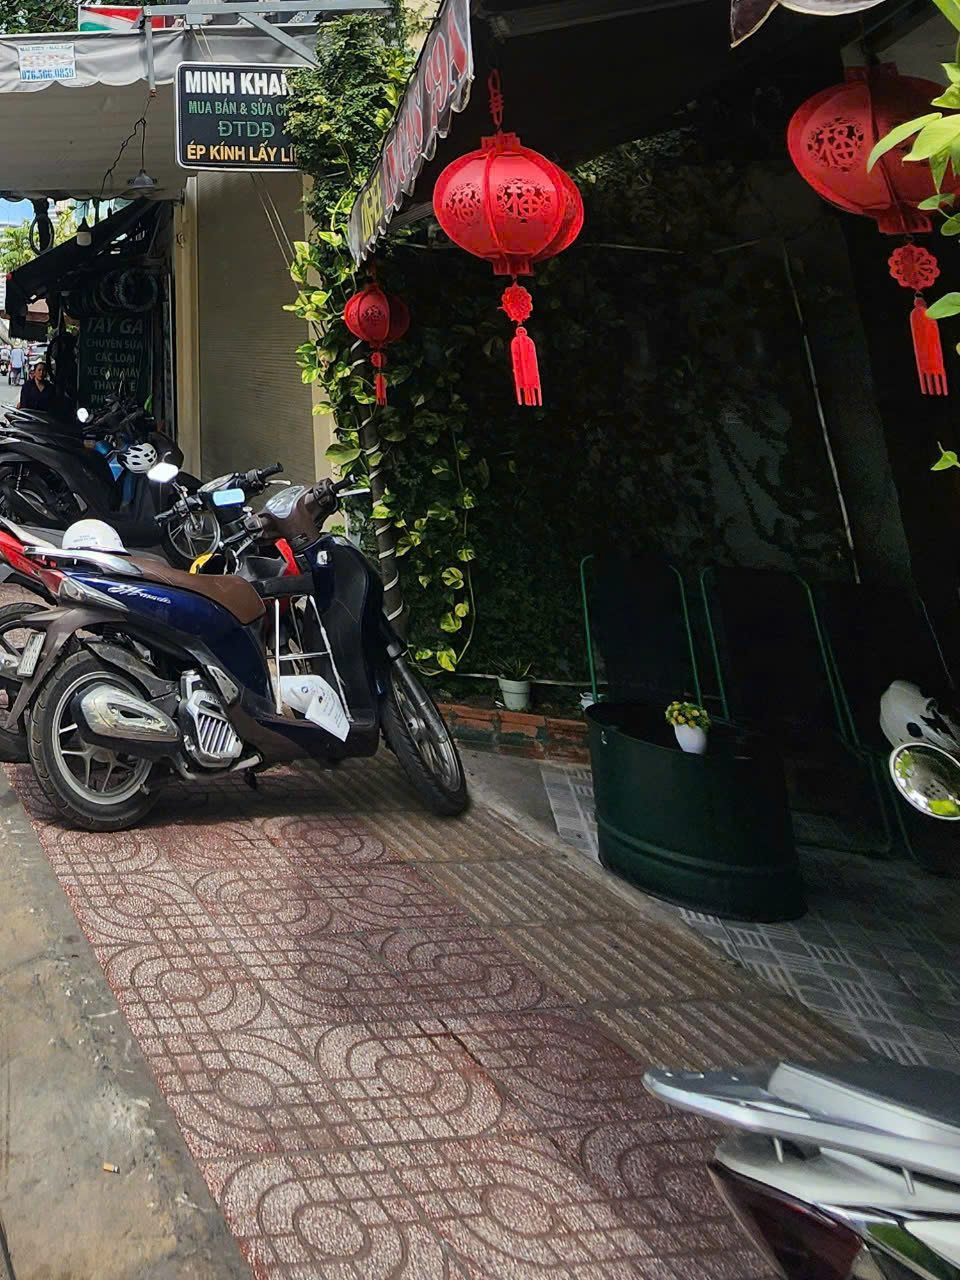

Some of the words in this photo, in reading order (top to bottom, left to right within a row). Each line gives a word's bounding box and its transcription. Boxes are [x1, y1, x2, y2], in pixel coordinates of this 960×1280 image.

[185, 71, 235, 95] MINH
[240, 72, 295, 98] KHAN
[188, 100, 212, 114] MUA
[215, 98, 236, 114] BÁN
[240, 103, 247, 115] &
[251, 98, 273, 116] SỬA
[218, 120, 275, 138] ĐTDĐ
[187, 140, 206, 159] ÉP
[209, 141, 245, 161] KÍNH
[249, 140, 277, 162] LẤY
[119, 318, 144, 335] GA
